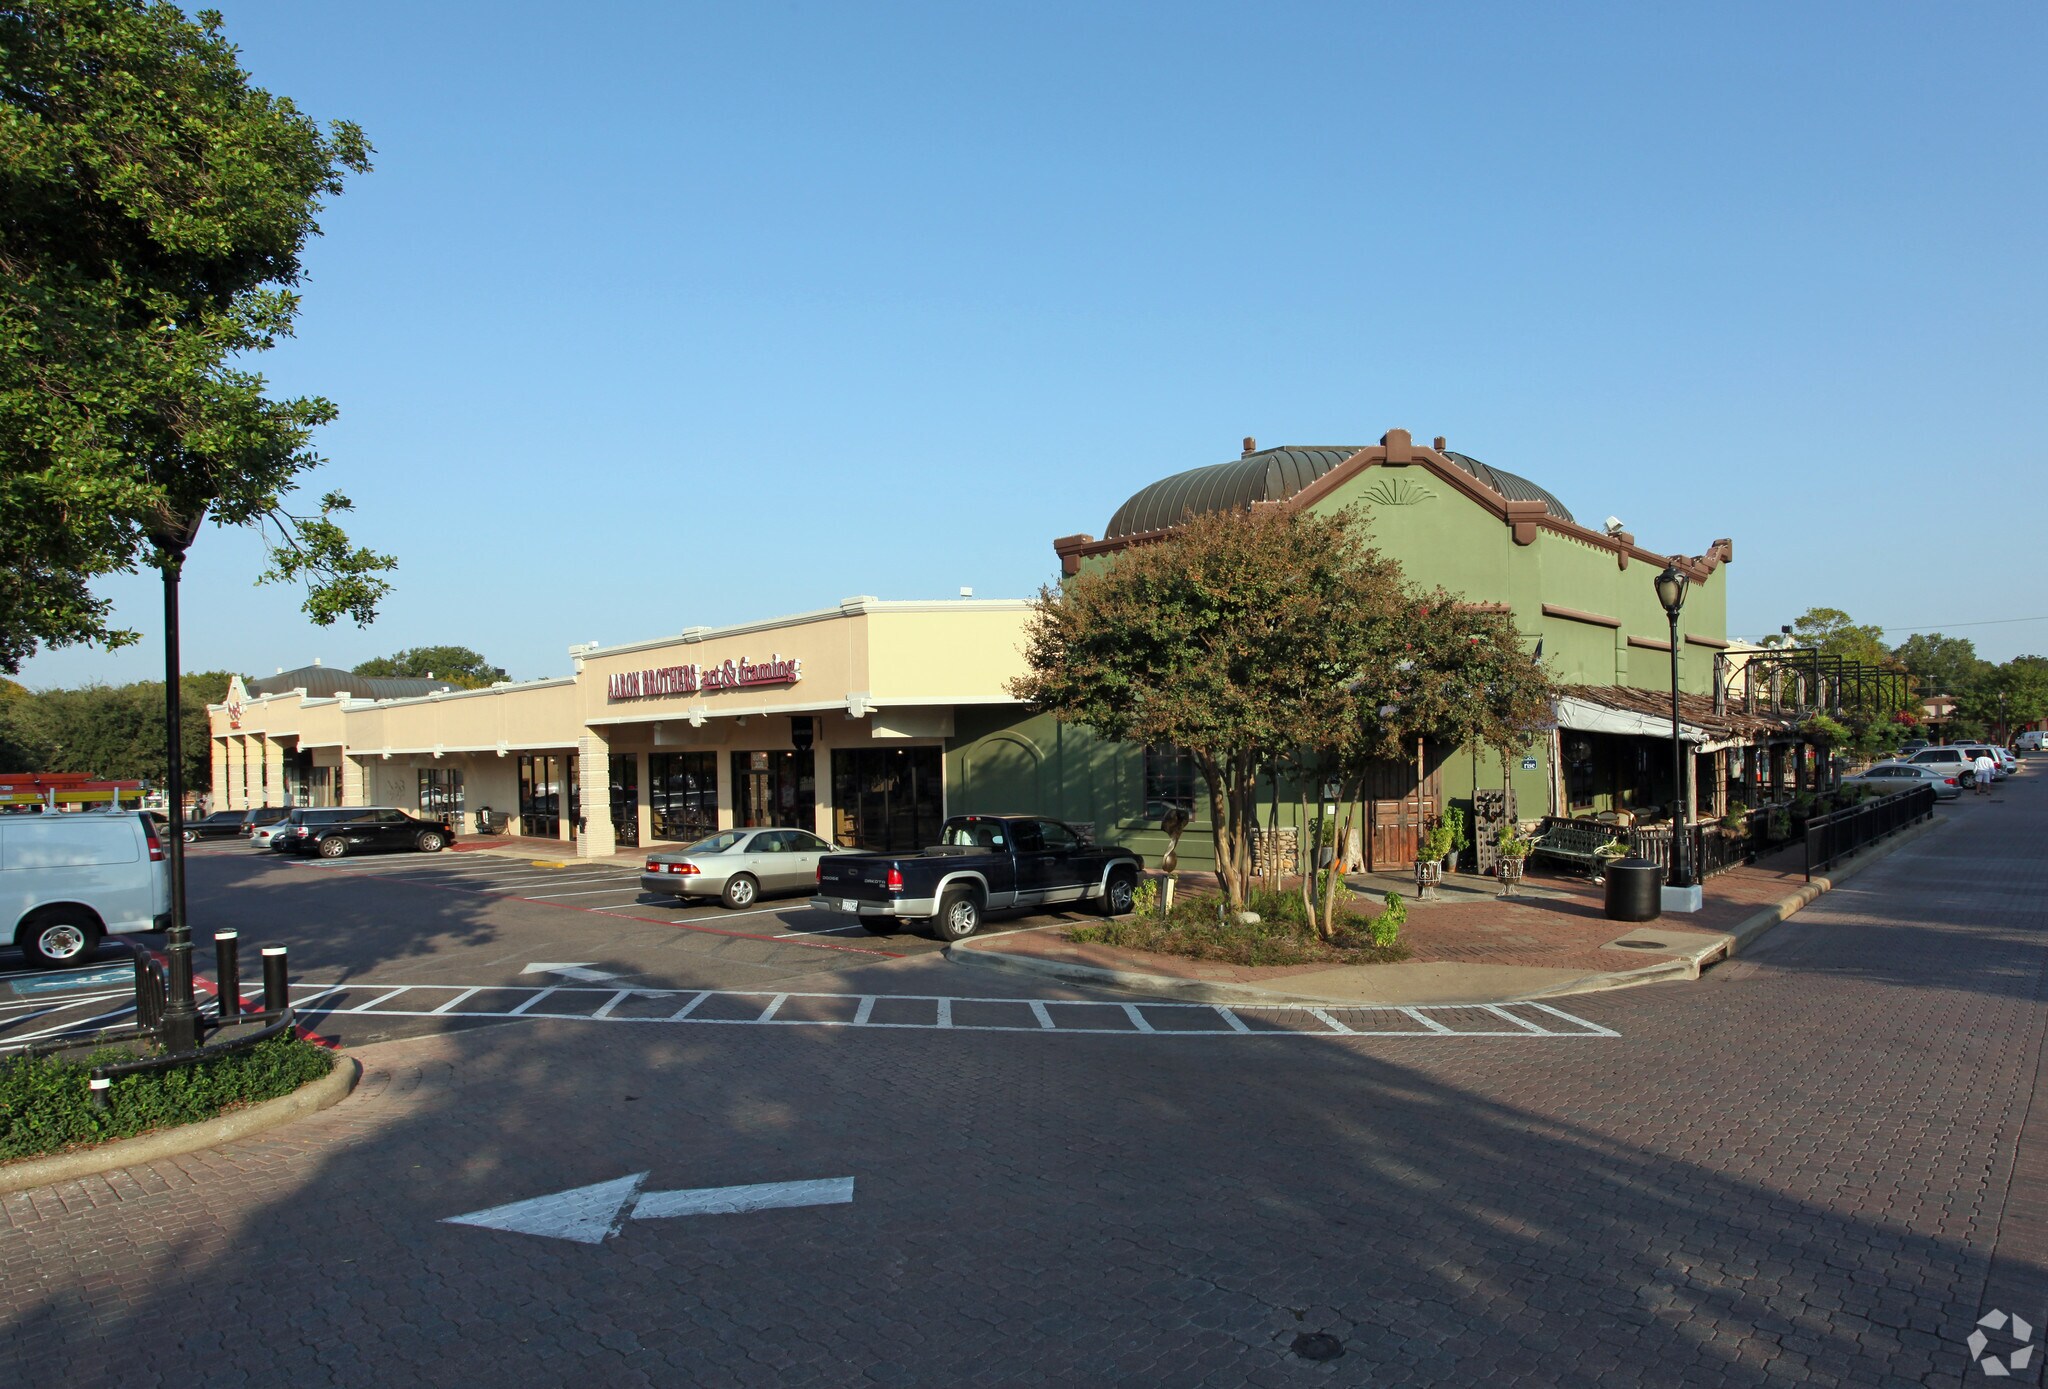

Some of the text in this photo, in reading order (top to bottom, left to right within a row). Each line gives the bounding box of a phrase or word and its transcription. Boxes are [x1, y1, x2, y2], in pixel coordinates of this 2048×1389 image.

[608, 654, 798, 699] AARON BROTHERS art & framing
